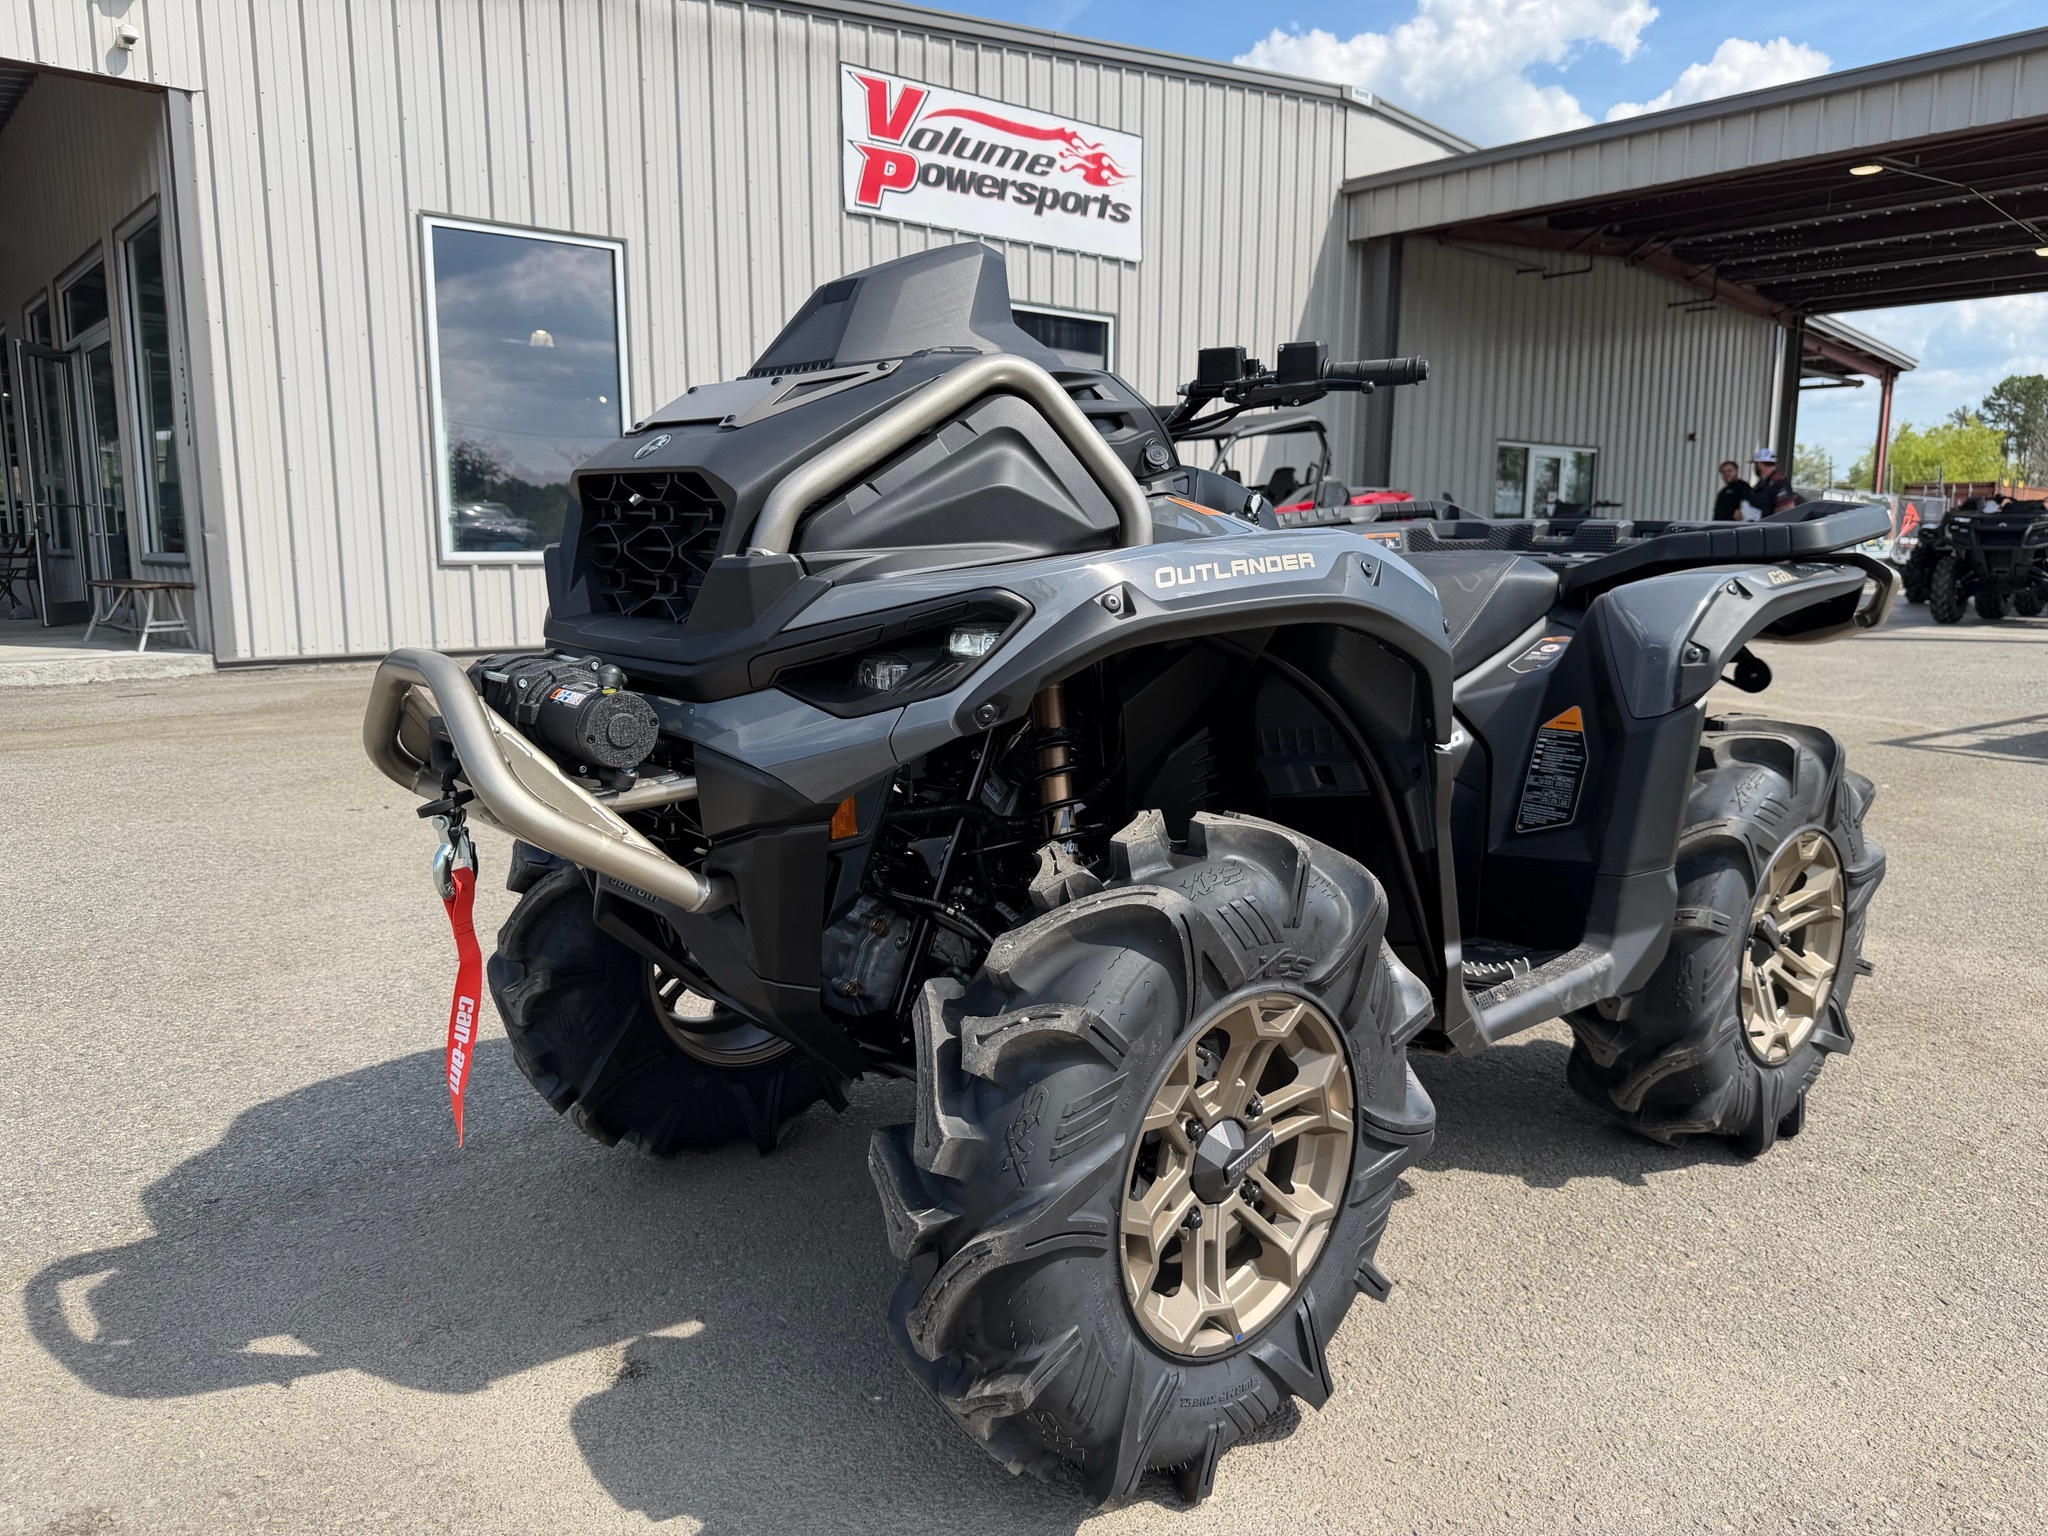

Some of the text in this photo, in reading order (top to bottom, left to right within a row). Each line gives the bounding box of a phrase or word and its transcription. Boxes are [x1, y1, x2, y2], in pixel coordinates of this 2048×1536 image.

[848, 68, 1058, 178] Volume
[848, 140, 1133, 224] Powersports
[1154, 552, 1316, 589] OUTLANDER
[449, 995, 475, 1096] can-am
